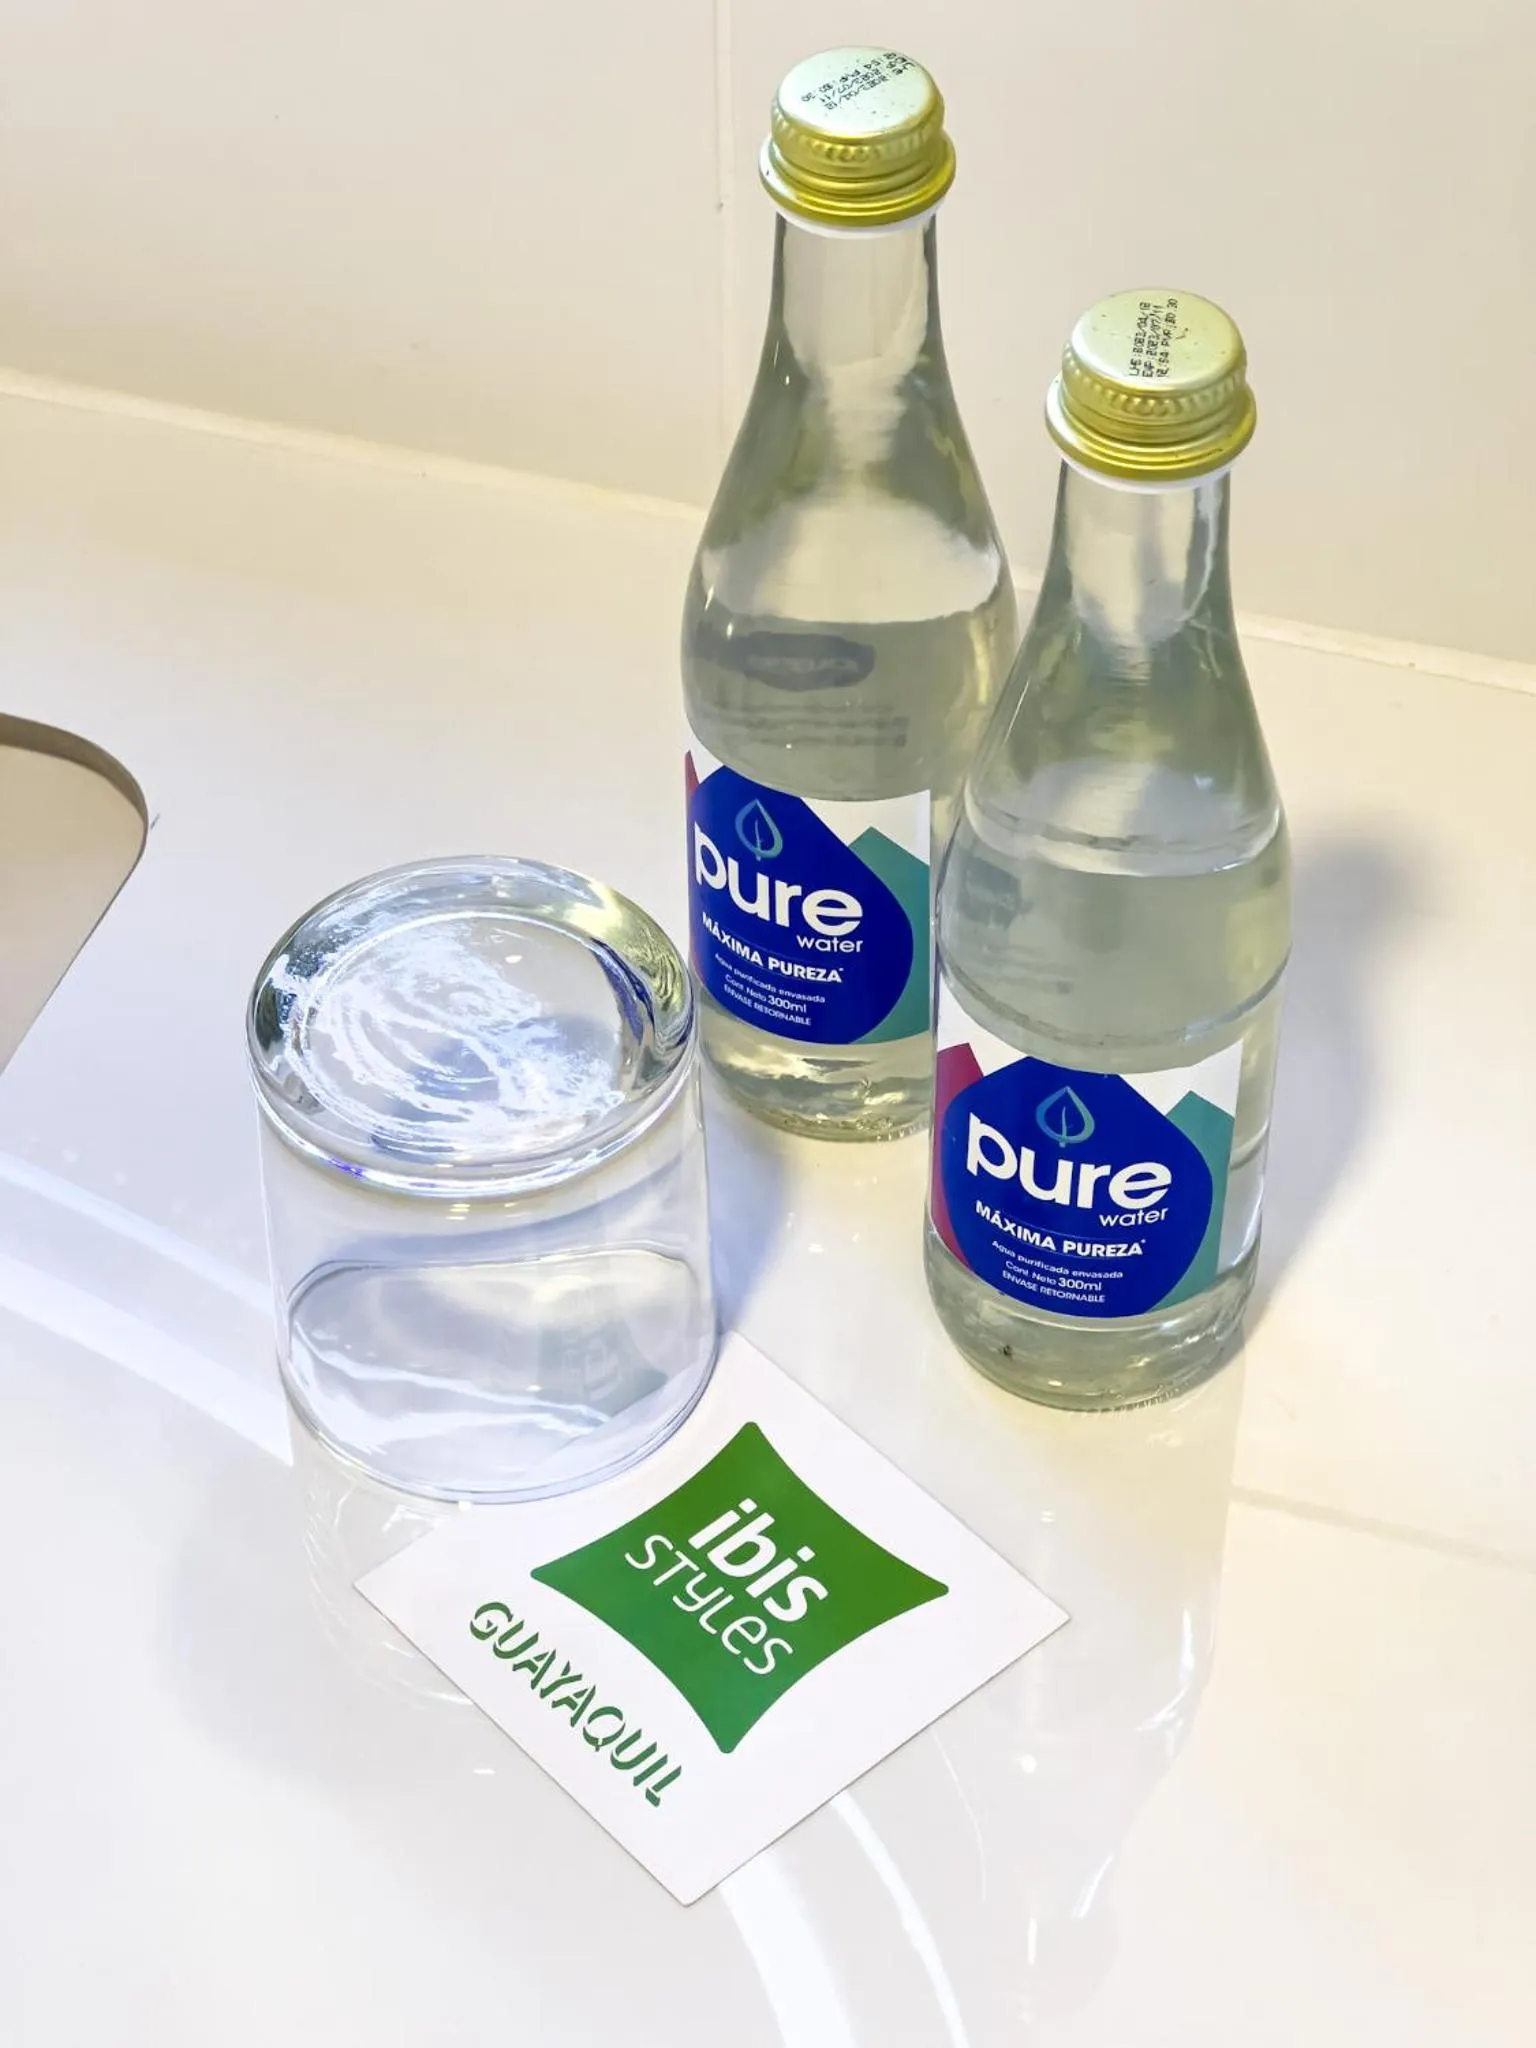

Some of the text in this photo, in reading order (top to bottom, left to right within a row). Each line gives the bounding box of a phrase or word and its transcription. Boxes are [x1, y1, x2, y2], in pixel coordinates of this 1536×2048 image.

[693, 821, 864, 937] pure
[702, 911, 764, 966] MÁXIMA
[796, 935, 864, 953] water
[723, 983, 812, 1026] ENVASE RETORNABLE
[746, 988, 767, 1002] Neto
[767, 994, 808, 1014] 300ml
[778, 988, 826, 1004] envasada
[966, 1111, 1172, 1210] pure
[975, 1199, 1056, 1251] MÁXIMA
[1099, 1207, 1169, 1228] water
[992, 1240, 1124, 1280] Agua purificada envasada
[1002, 1270, 1106, 1304] ENVASE RETORNABLE
[1031, 1271, 1057, 1286] Neto
[1057, 1277, 1103, 1292] 300ml
[687, 1497, 829, 1622] ibis
[469, 1601, 683, 1807] GUAYAQUIL
